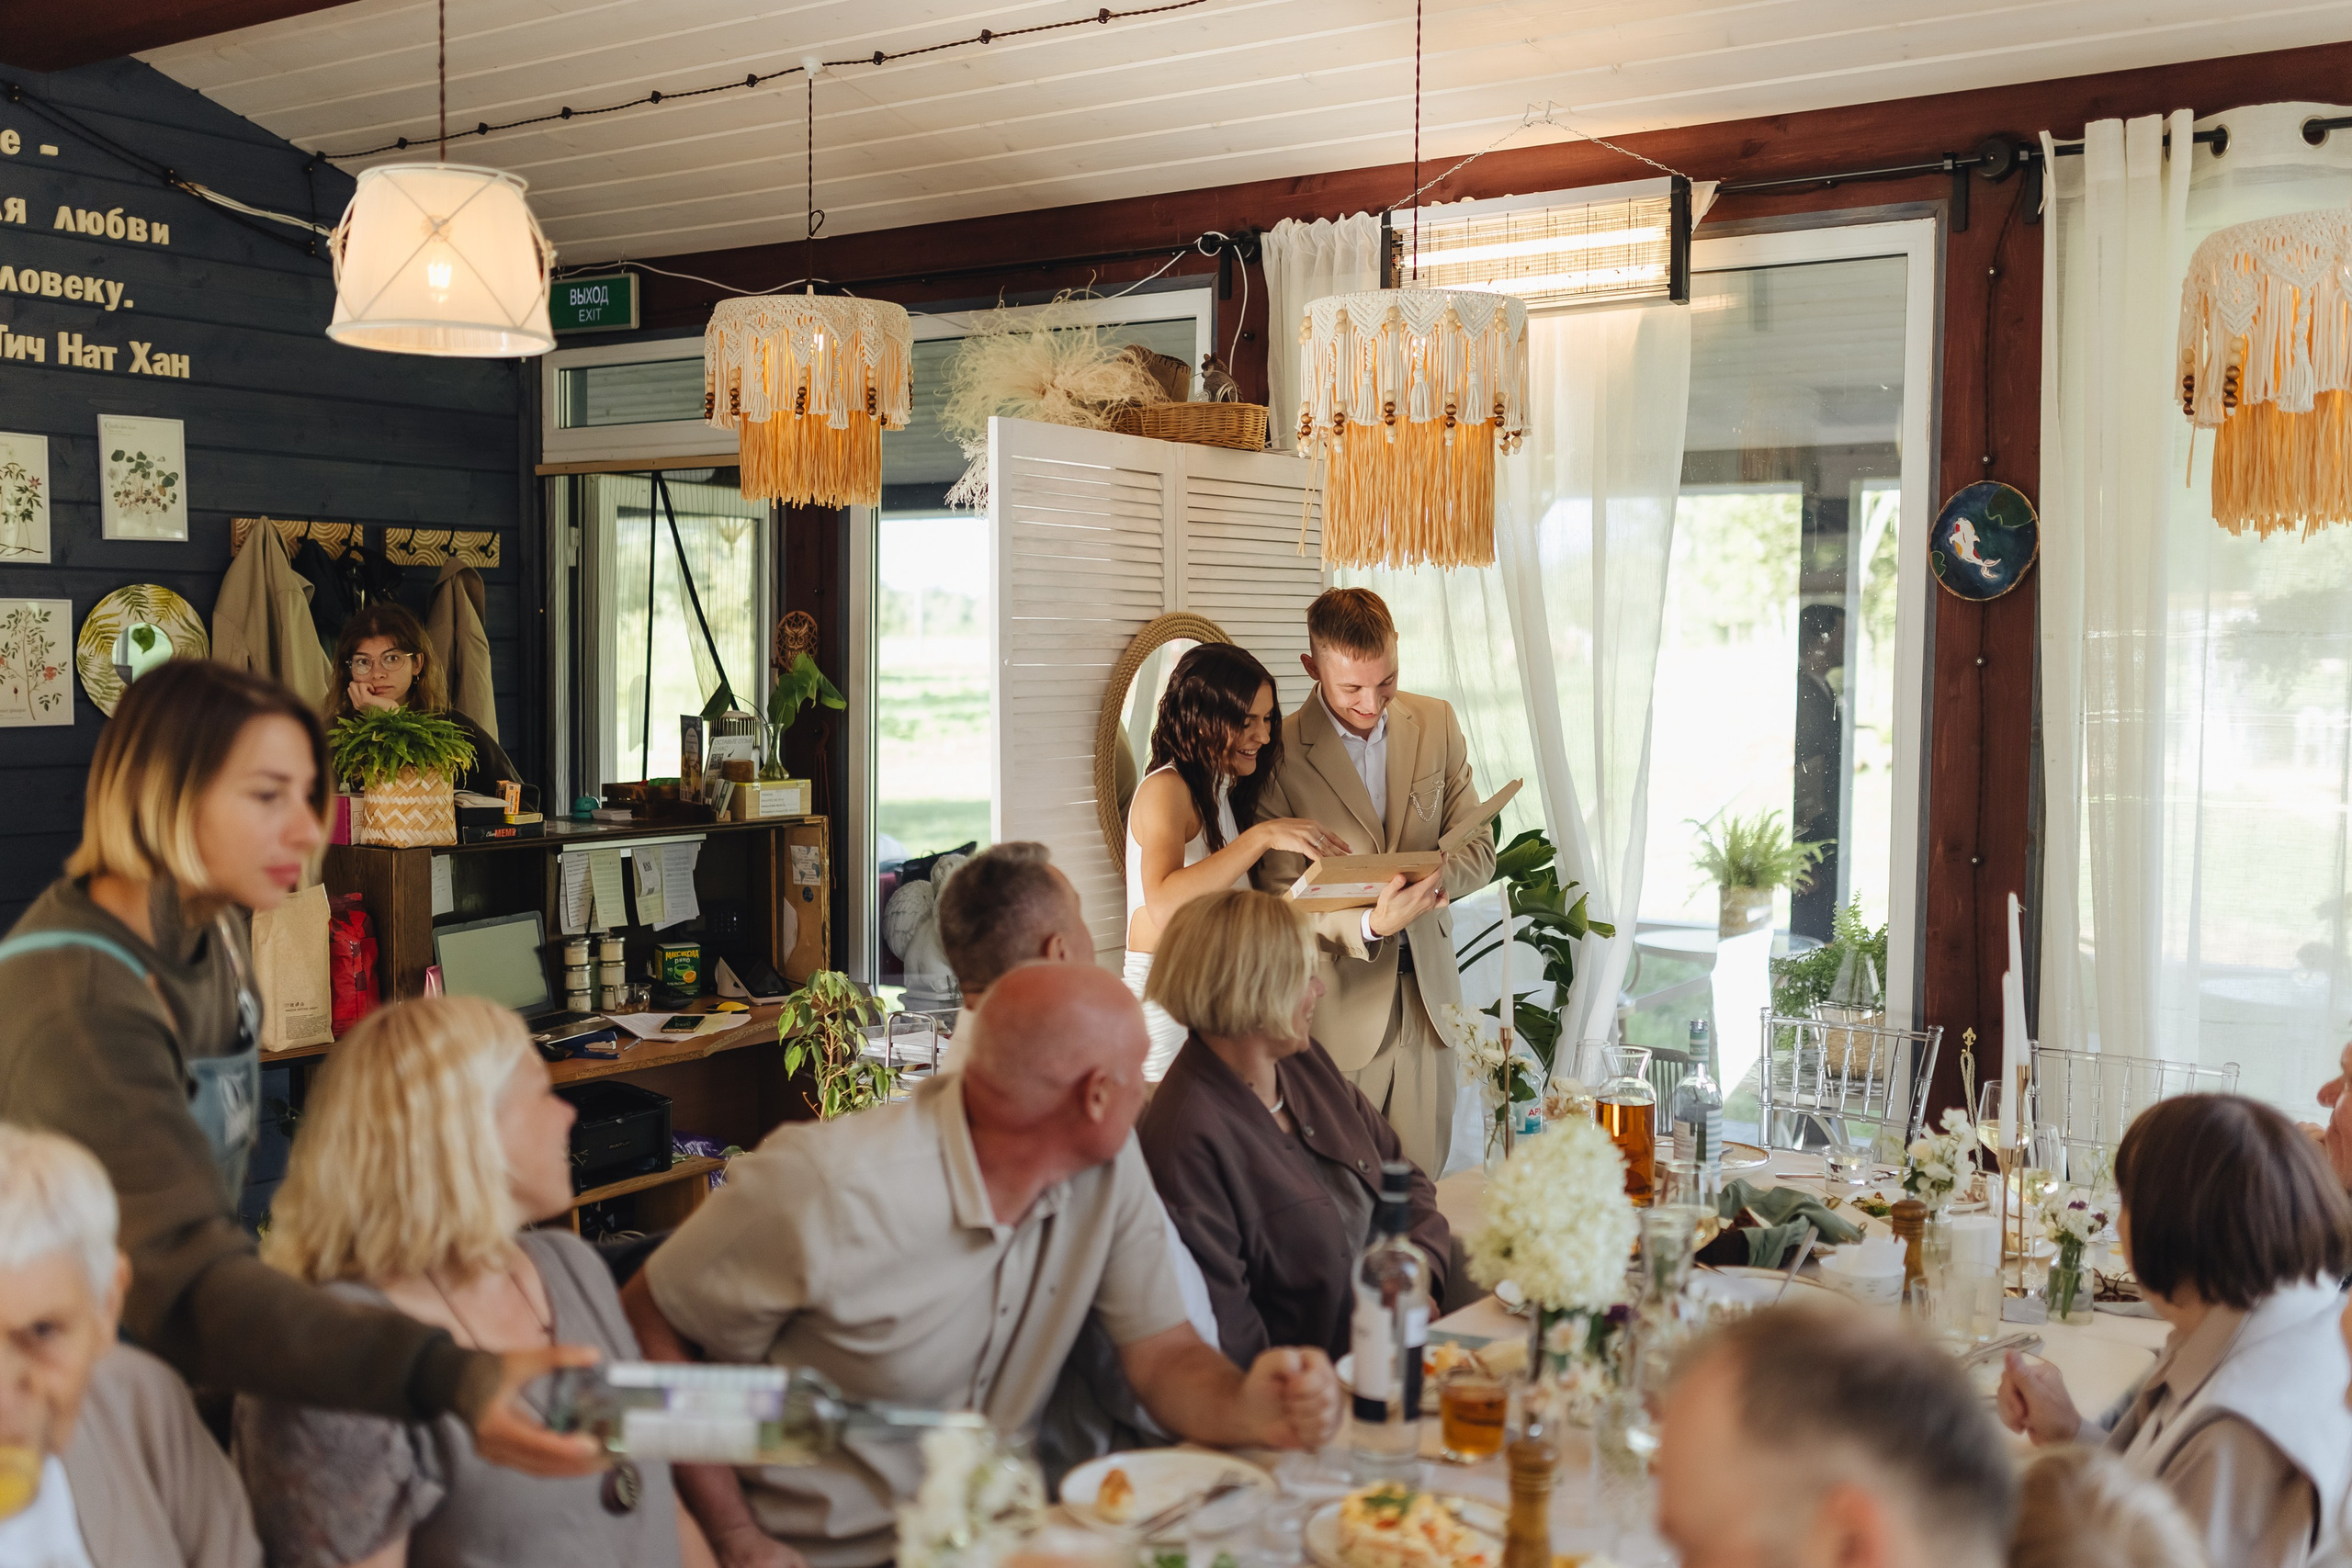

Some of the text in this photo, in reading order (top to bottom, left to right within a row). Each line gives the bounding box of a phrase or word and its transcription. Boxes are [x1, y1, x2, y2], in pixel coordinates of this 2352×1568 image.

[0, 197, 169, 245] я любви
[0, 265, 134, 311] ловеку.
[570, 286, 608, 306] ВЫХОД
[579, 308, 602, 321] EXIT
[57, 331, 118, 371] Нат
[129, 341, 190, 378] Хан
